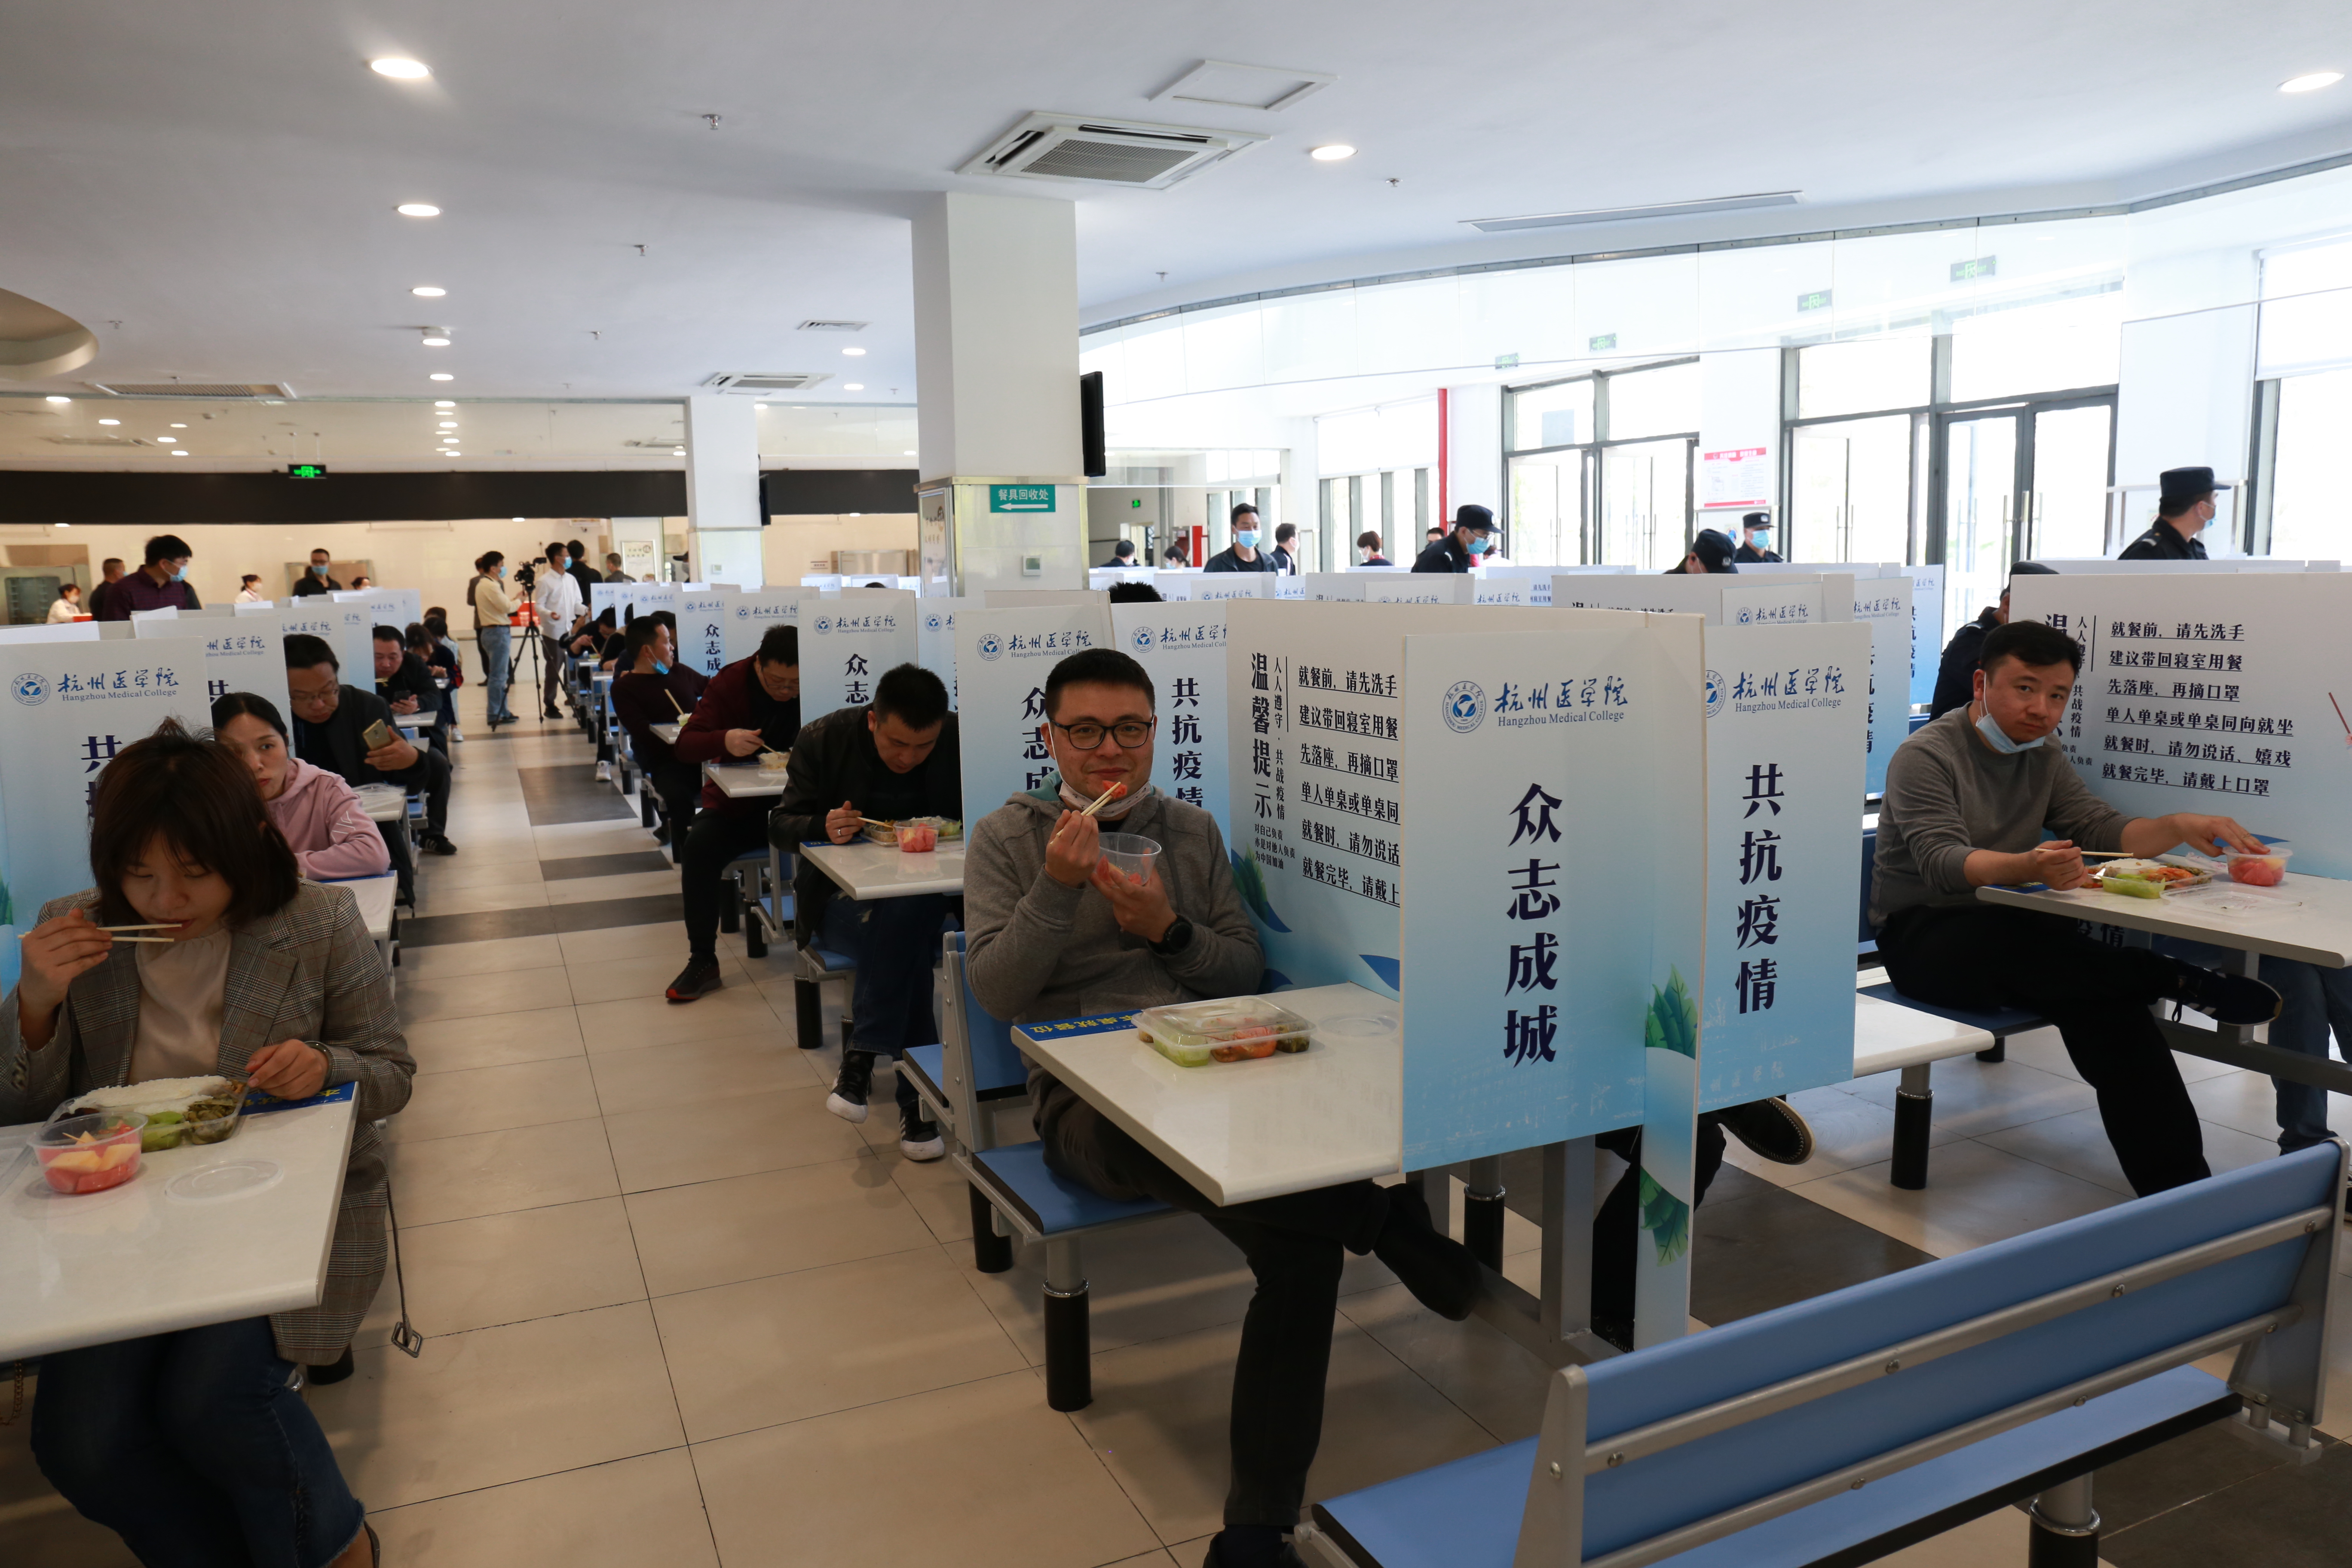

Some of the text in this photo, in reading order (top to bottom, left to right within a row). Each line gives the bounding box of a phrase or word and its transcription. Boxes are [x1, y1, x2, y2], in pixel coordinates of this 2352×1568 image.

[998, 489, 1049, 500] 餐具回收处
[1477, 592, 1520, 603] 杭州医学院
[836, 615, 896, 628] 杭州医学院
[1756, 604, 1808, 621] 杭州医学院
[705, 624, 721, 679] 众志成
[1008, 630, 1092, 651] 杭州医学院
[2109, 650, 2242, 671] 建议带回寝室用餐
[58, 668, 179, 693] 杭州医学院
[845, 653, 869, 704] 众志
[1733, 666, 1844, 700] 杭州医学院
[62, 689, 177, 701] Hangzhou Medical College
[1494, 676, 1628, 713] 杭州医学院
[1735, 698, 1841, 713] Hangzhou Medical College
[1299, 704, 1398, 739] 建议带回寝室用餐
[1498, 710, 1624, 728] Hangzhou Medical College
[2106, 707, 2294, 736] 单人单桌或单桌同向就坐
[1171, 678, 1204, 808] 共抗疫情
[1251, 652, 1272, 818] 温馨提示
[1301, 743, 1398, 780] 先落座，再摘口罩
[1302, 781, 1399, 823] 单人单桌或单桌同
[1255, 823, 1283, 841] 对自己负责
[1255, 837, 1295, 859] 亦是对他人负责
[1255, 851, 1283, 870] 为中国加油
[1735, 763, 1785, 1015] 共抗疫情
[1503, 782, 1563, 1068] 众志成城
